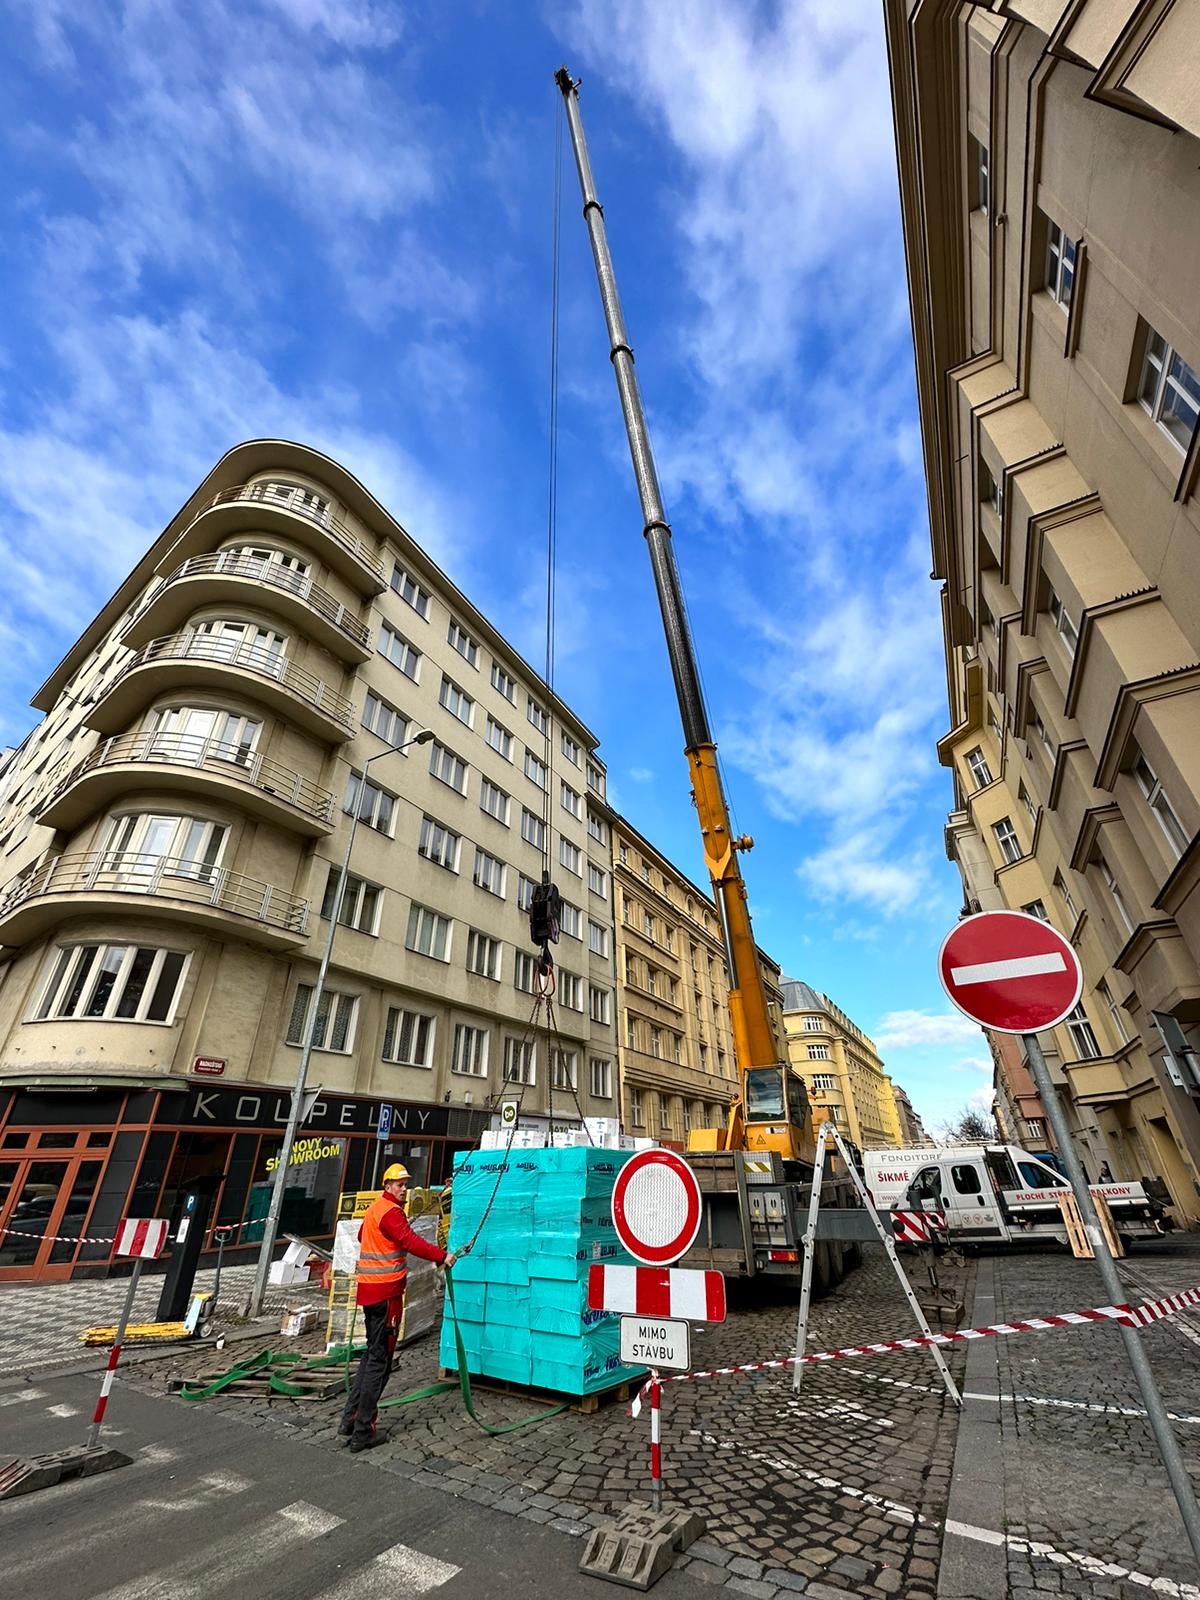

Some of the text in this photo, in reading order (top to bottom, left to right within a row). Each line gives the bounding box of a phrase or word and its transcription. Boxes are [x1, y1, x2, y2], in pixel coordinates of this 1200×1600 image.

[381, 1109, 390, 1128] P
[265, 1144, 340, 1171] SHWROOM
[877, 1170, 909, 1182] ŠIKMÉ
[1015, 1191, 1045, 1201] PLOCHÉ
[639, 1326, 667, 1340] MIMO
[632, 1344, 674, 1360] STAVBU
